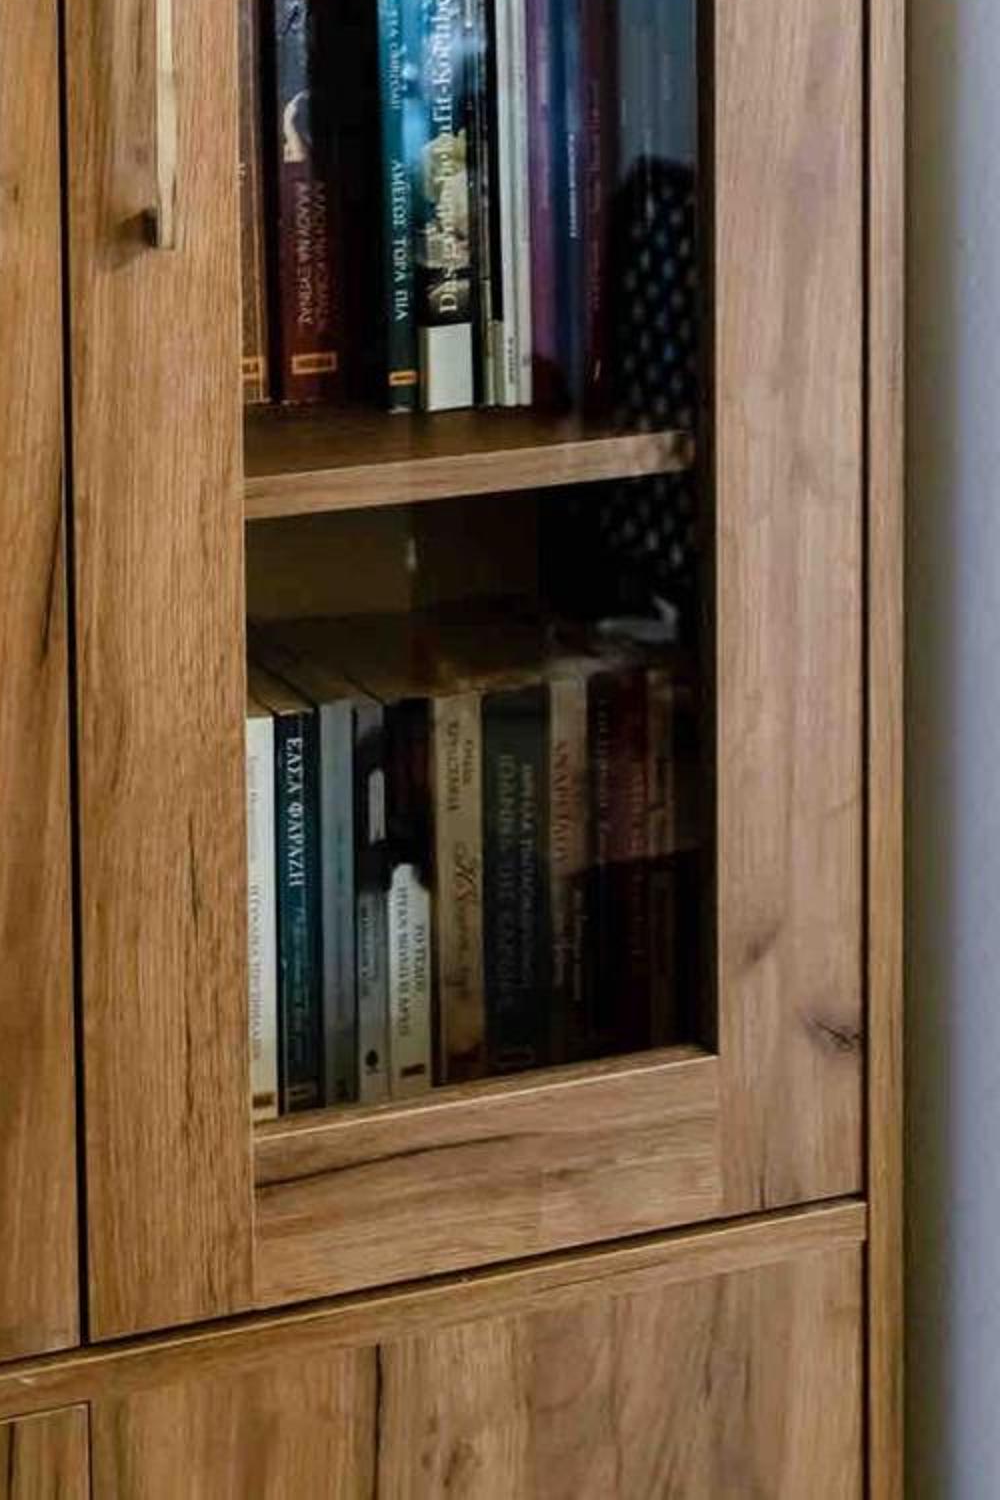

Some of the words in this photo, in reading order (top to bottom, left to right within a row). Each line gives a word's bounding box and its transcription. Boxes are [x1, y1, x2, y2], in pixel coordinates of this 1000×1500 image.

[393, 235, 408, 283] ΤΩΡΑ
[394, 289, 409, 321] ΠΙΑ
[285, 736, 305, 794] ΕΛΣΑ
[286, 801, 306, 888] ΦΑΡΑΖΗ
